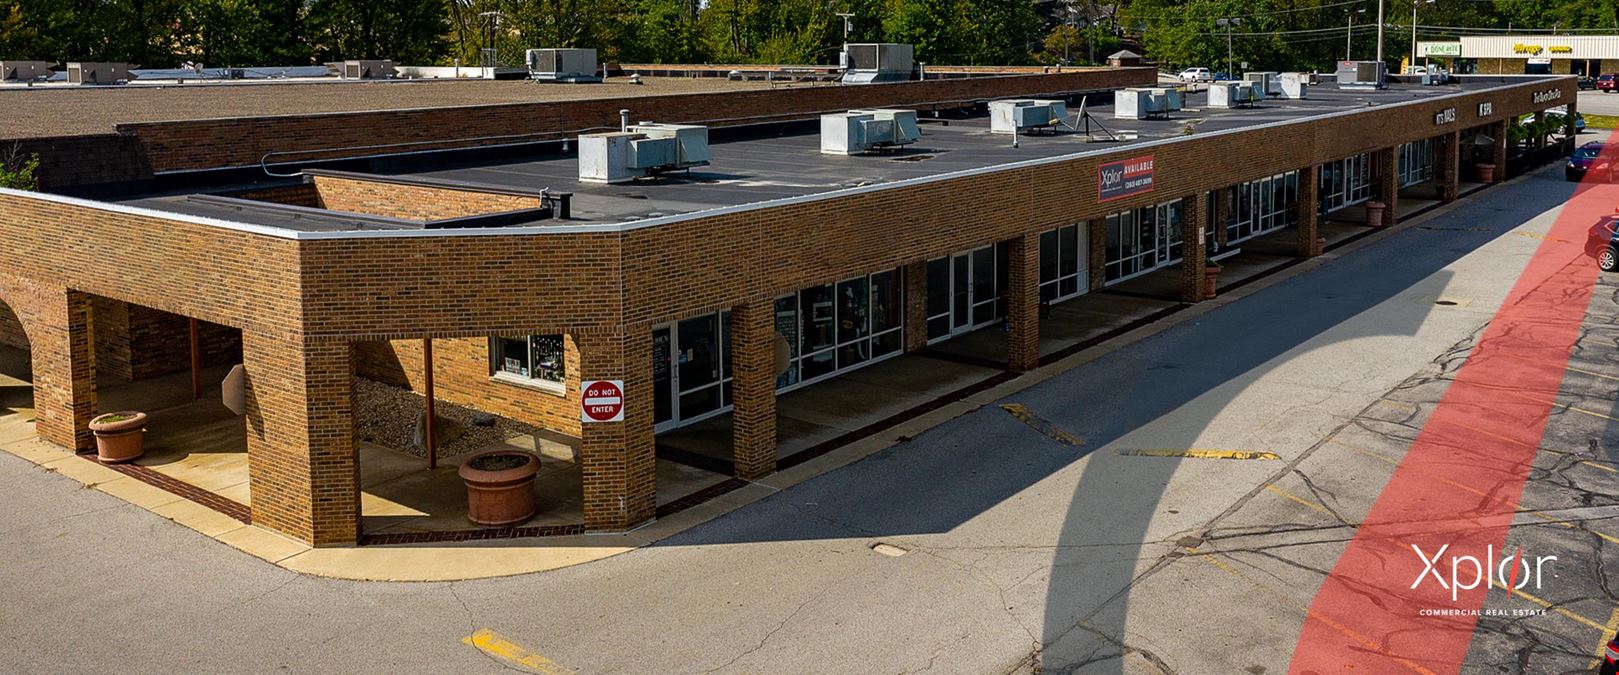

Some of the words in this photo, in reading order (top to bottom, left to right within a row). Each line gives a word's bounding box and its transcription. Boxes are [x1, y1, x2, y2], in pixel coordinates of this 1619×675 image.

[1444, 108, 1456, 123] NAILS
[1124, 160, 1153, 175] AVAILABLE
[1101, 168, 1123, 188] Xplor
[589, 389, 599, 397] DO
[602, 388, 616, 396] NOT
[591, 405, 614, 414] ENTER
